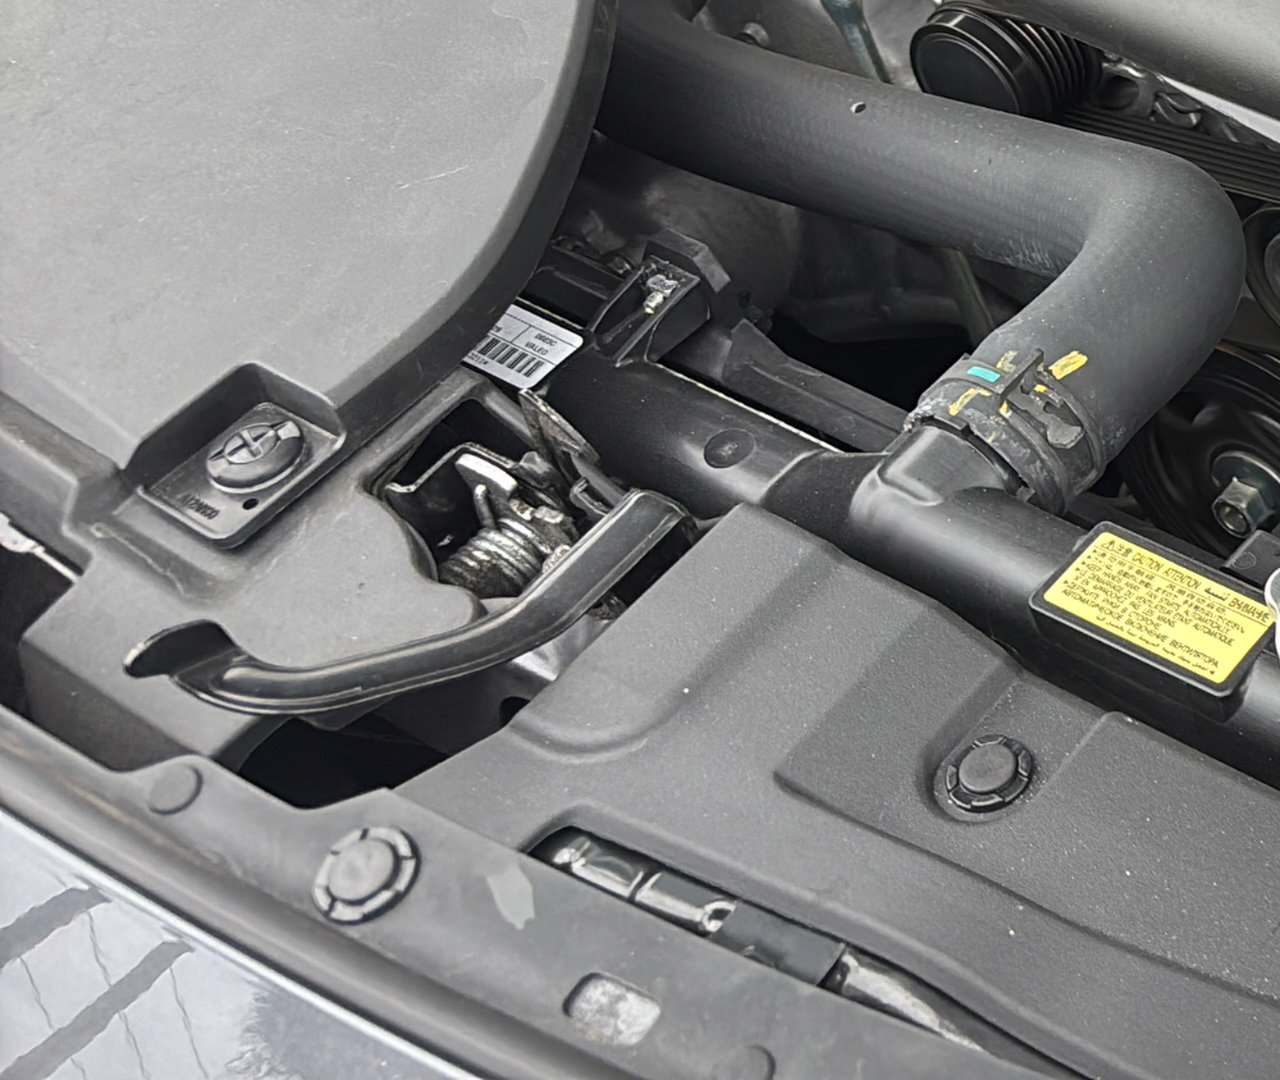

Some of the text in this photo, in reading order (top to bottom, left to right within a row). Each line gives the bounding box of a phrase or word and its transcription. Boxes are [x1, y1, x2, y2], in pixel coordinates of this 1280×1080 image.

[523, 340, 549, 355] VALEO
[1130, 551, 1164, 572] CAUTION
[1162, 566, 1202, 590] ATTENTION
